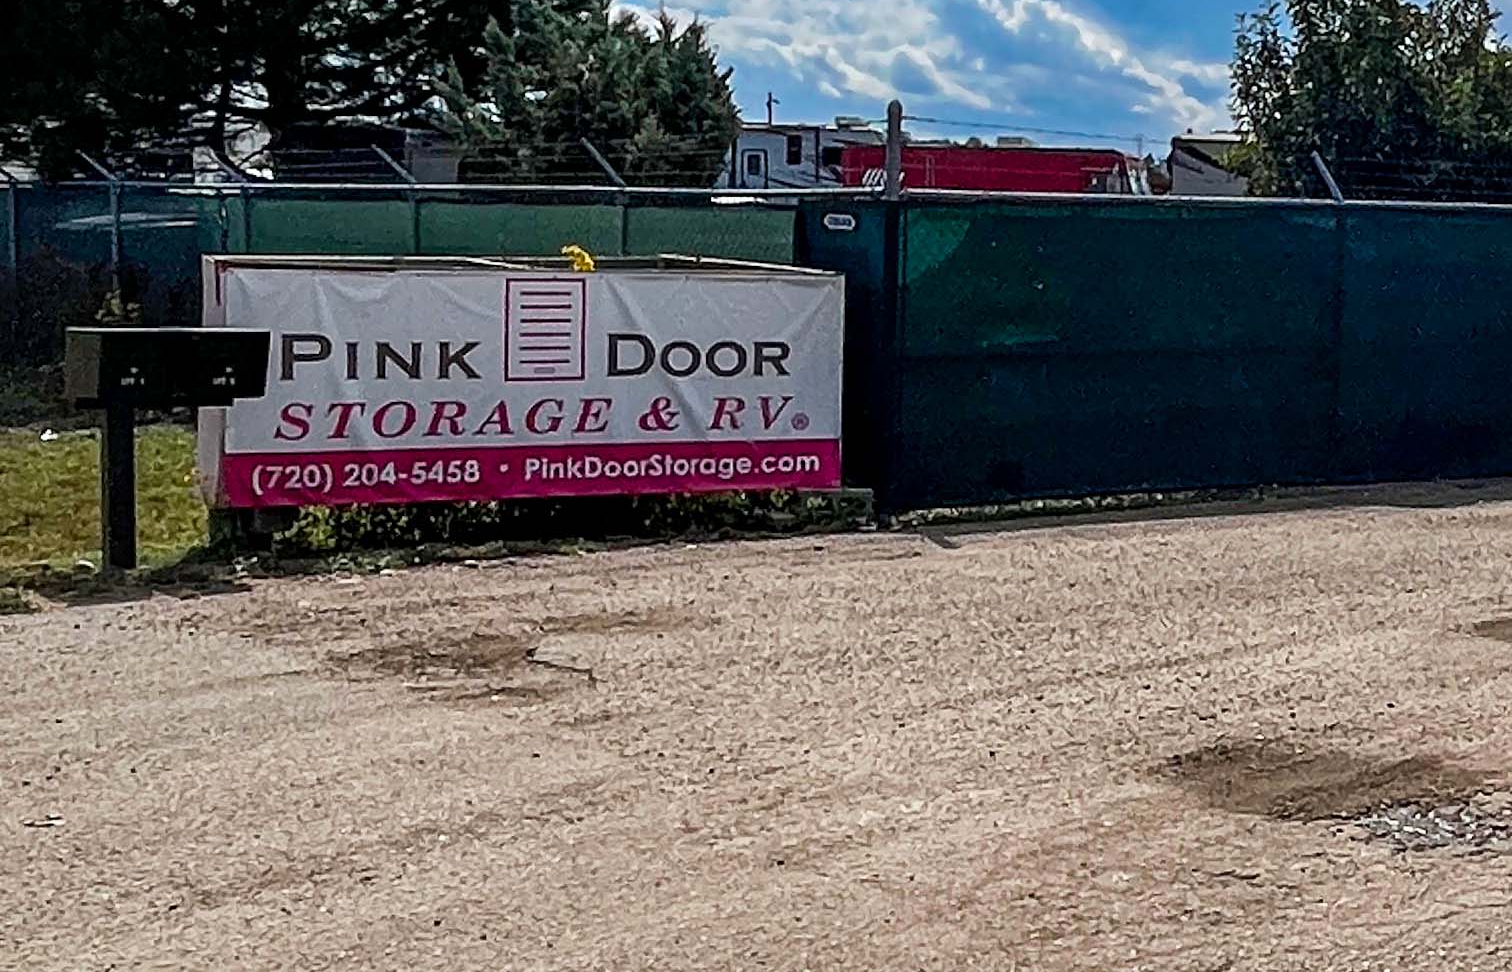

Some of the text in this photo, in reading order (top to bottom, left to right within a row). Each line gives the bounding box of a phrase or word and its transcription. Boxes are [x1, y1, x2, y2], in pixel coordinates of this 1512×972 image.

[279, 332, 791, 380] PINK DOOR
[274, 398, 612, 441] STORAGE
[638, 396, 680, 432] &
[252, 453, 820, 496] (720) 204-5458 PinkDoorStorage.com
